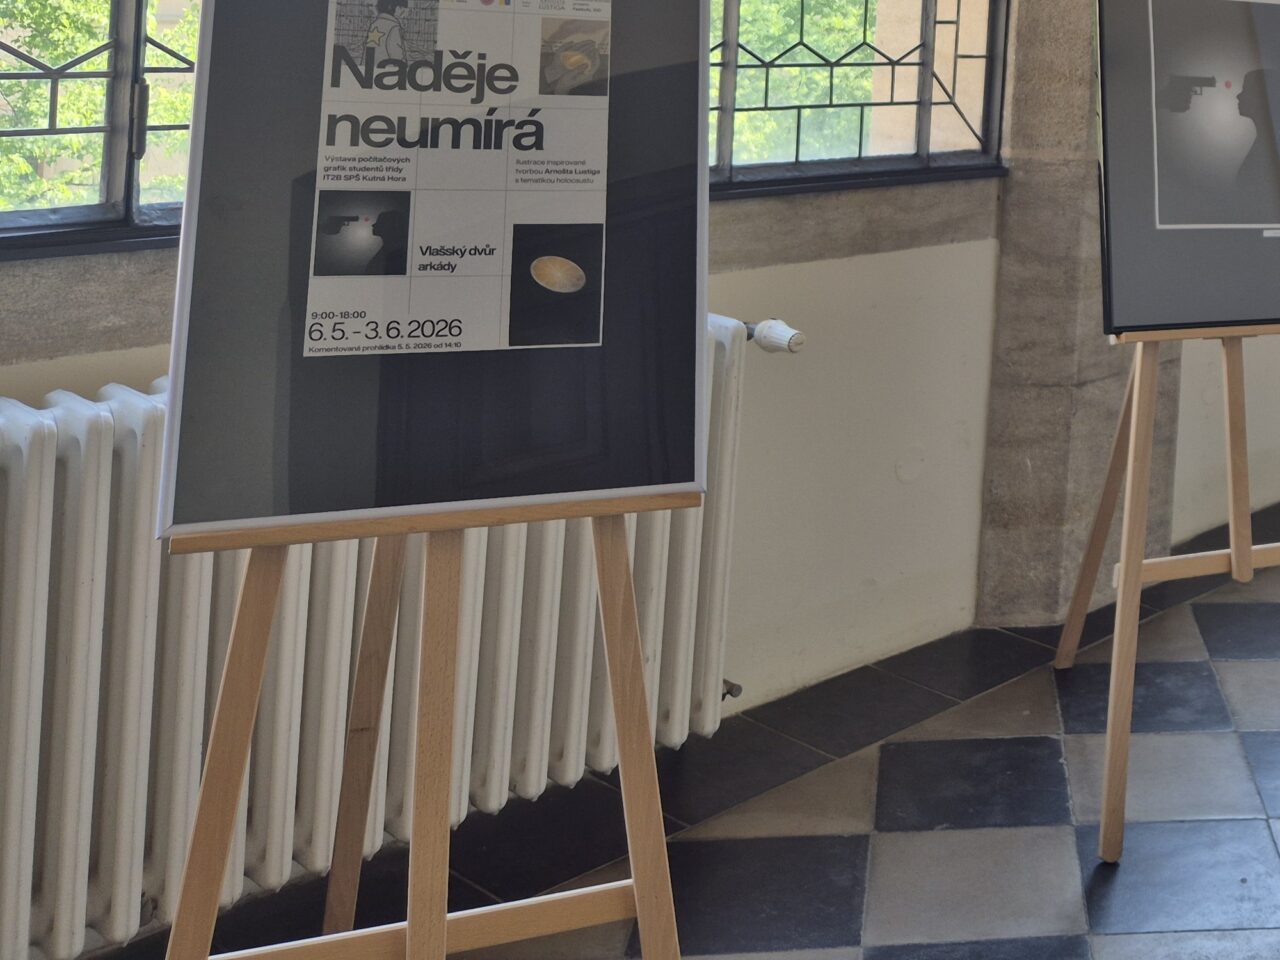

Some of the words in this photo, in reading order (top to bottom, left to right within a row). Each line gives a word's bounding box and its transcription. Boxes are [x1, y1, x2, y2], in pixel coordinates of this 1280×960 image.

[330, 44, 519, 105] Naděje
[325, 107, 545, 151] neumírá
[358, 155, 411, 164] počítačových
[323, 165, 346, 173] grafik
[348, 165, 384, 173] studentů
[385, 166, 403, 174] třídy
[343, 173, 360, 182] SPŠ
[362, 174, 386, 182] Kutná
[419, 244, 468, 258] Vlašský
[468, 243, 497, 257] dvůr
[418, 260, 457, 274] arkády
[311, 310, 367, 320] 9:00-18:00
[407, 319, 463, 339] 2026
[308, 345, 361, 353] Komentovaná
[362, 343, 396, 352] prohlídka
